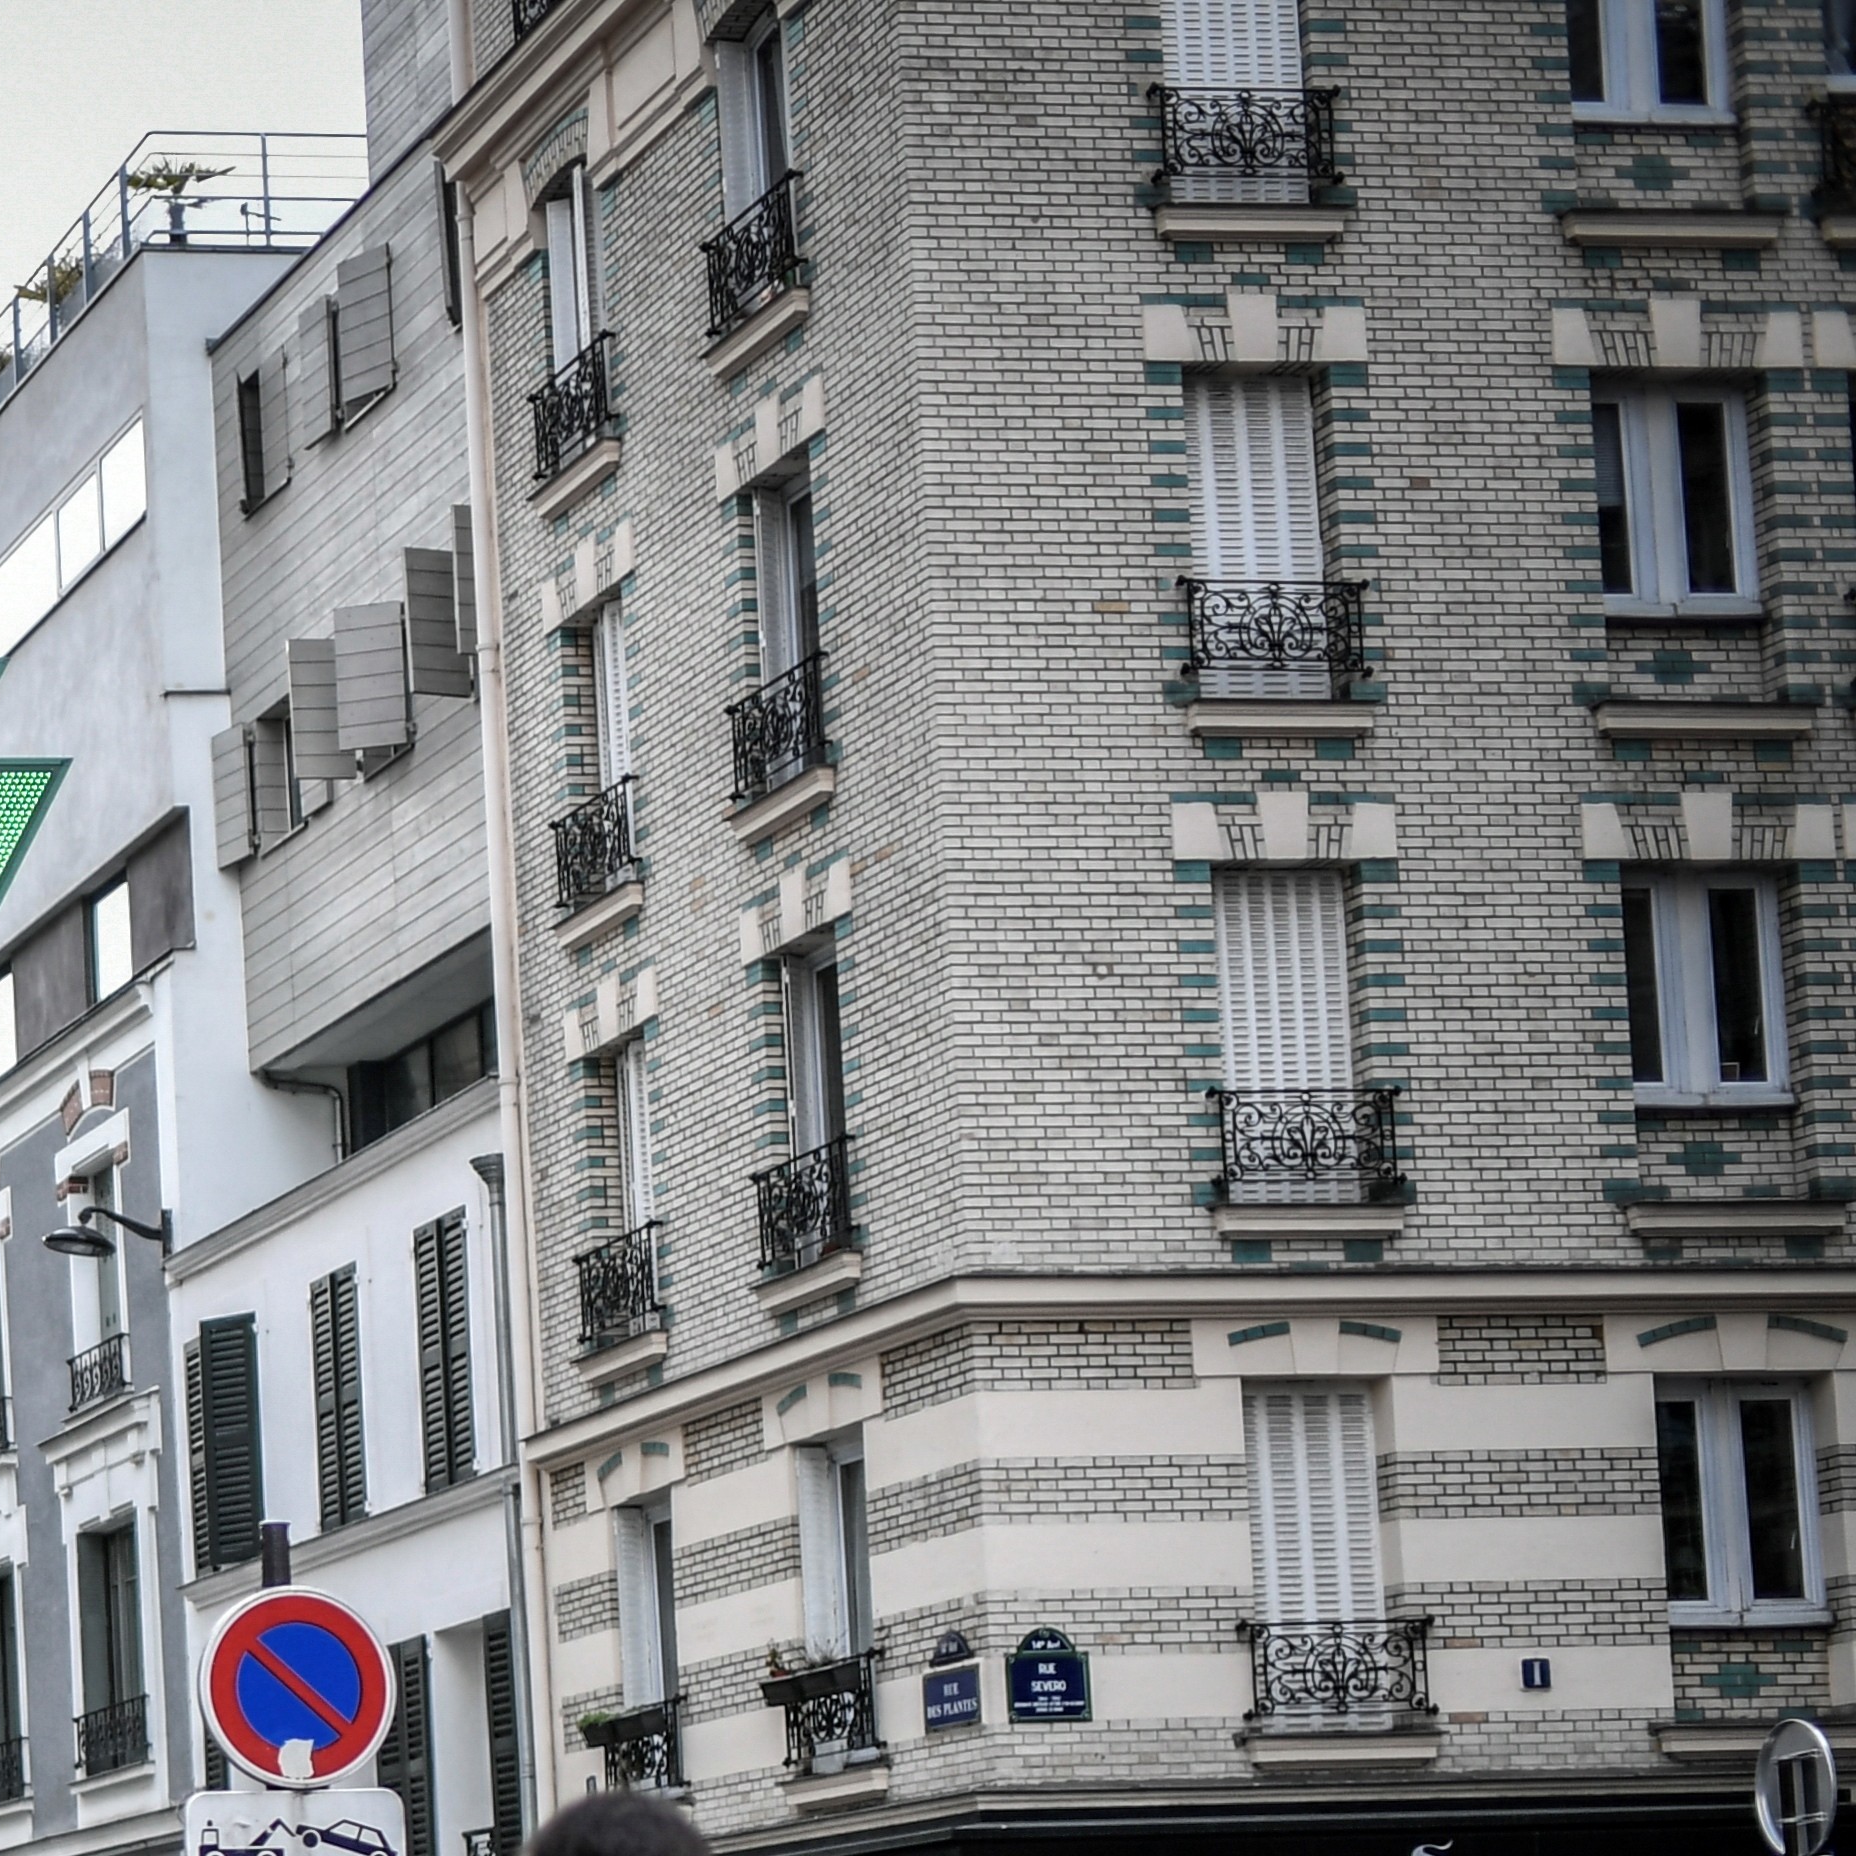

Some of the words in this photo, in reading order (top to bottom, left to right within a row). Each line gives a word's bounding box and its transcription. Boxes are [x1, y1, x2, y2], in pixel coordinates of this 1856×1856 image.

[1037, 1662, 1056, 1675] RUE
[943, 1682, 960, 1697] RUE
[1030, 1680, 1067, 1693] SEVERO
[926, 1703, 942, 1719] DES
[943, 1698, 978, 1716] PLANTES
